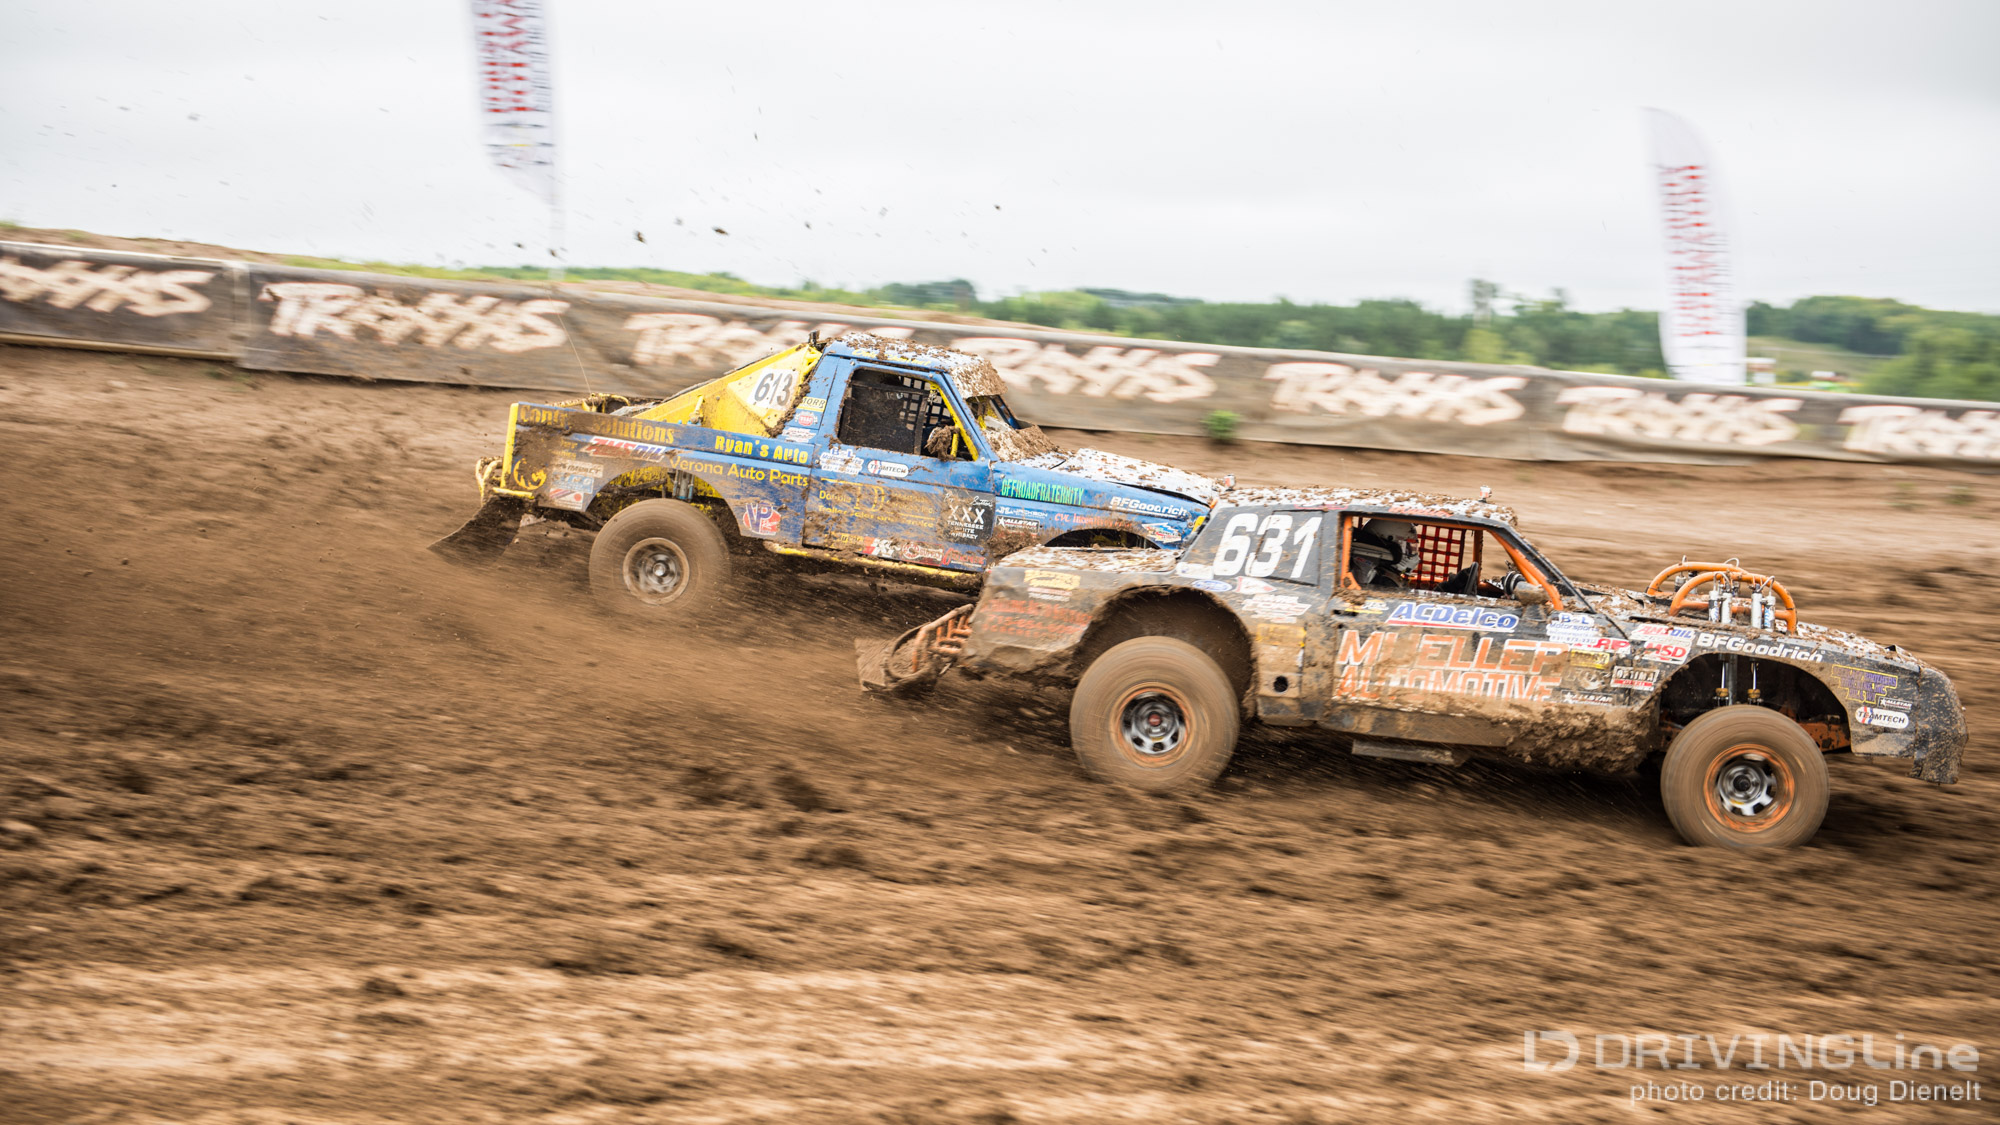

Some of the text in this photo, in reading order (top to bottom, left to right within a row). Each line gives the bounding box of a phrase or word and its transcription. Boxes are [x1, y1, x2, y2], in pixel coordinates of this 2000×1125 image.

[753, 373, 793, 406] 613
[714, 435, 769, 458] Ryan's
[773, 445, 809, 464] Auto
[670, 455, 809, 487] Verona Auto Parts
[869, 464, 906, 474] TEAMTECH
[745, 502, 773, 533] VP
[1213, 513, 1323, 579] 631
[1391, 602, 1518, 629] ACDelco
[1637, 625, 1692, 639] AMSOIL
[1643, 642, 1687, 658] MSD
[1696, 632, 1823, 663] BFGoodrich
[1615, 667, 1656, 683] OPTIMA
[1858, 711, 1906, 724] TEAMTECH
